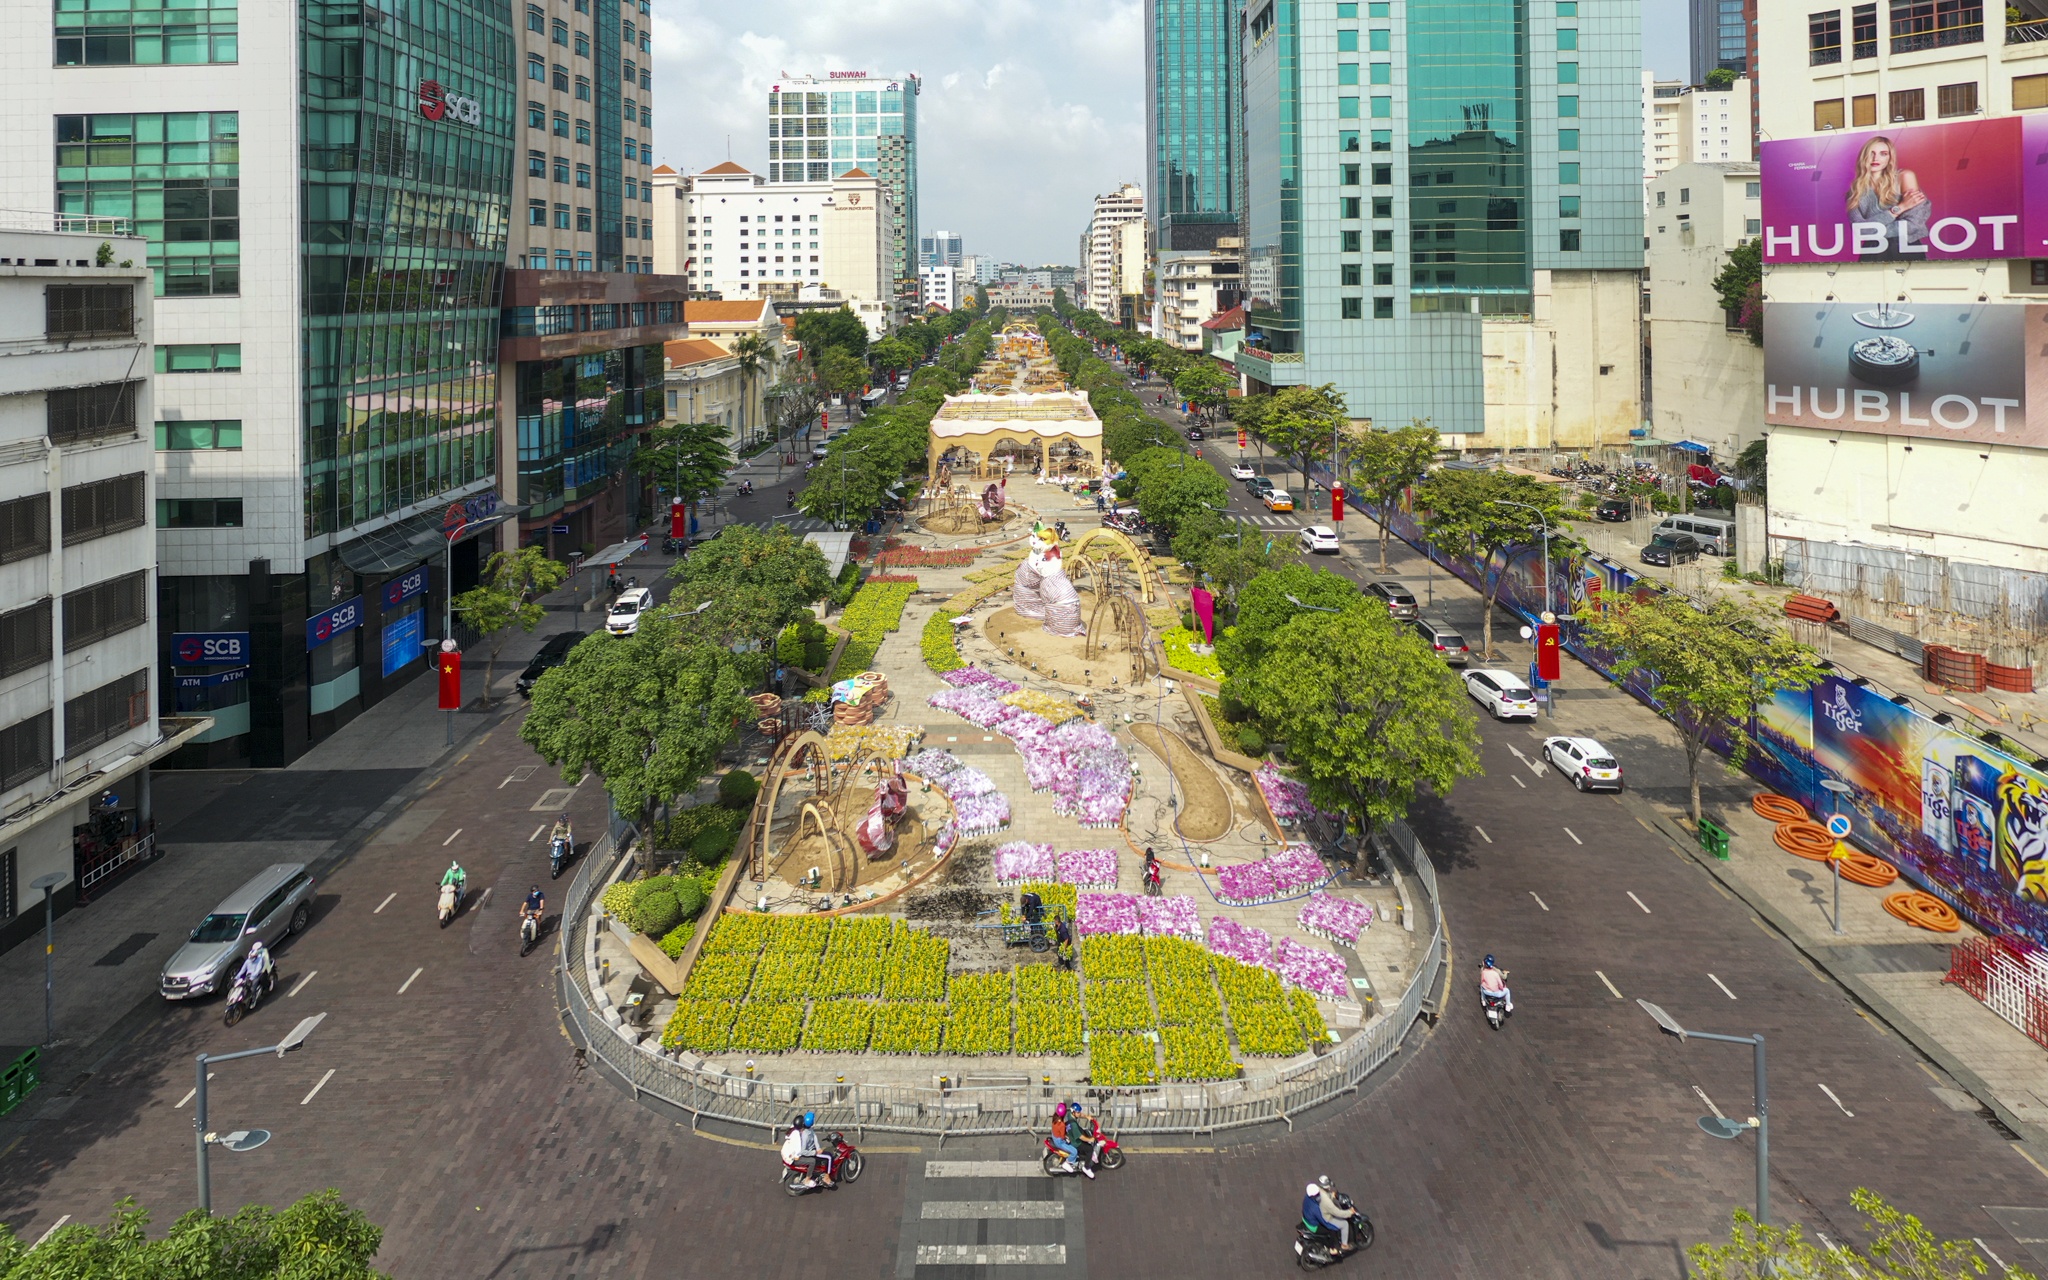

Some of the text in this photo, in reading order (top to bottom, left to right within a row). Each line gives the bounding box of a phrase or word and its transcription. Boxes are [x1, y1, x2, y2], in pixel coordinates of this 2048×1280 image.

[829, 71, 867, 79] SUNWAH
[445, 93, 480, 125] SCB
[1766, 215, 2018, 258] HUBLOT
[1767, 383, 2019, 433] HUBLOT
[465, 490, 497, 523] SCB
[402, 573, 421, 593] SCB
[332, 605, 355, 628] SCB
[203, 639, 241, 655] SCB
[222, 671, 244, 682] ATM
[1822, 700, 1862, 733] Tiger
